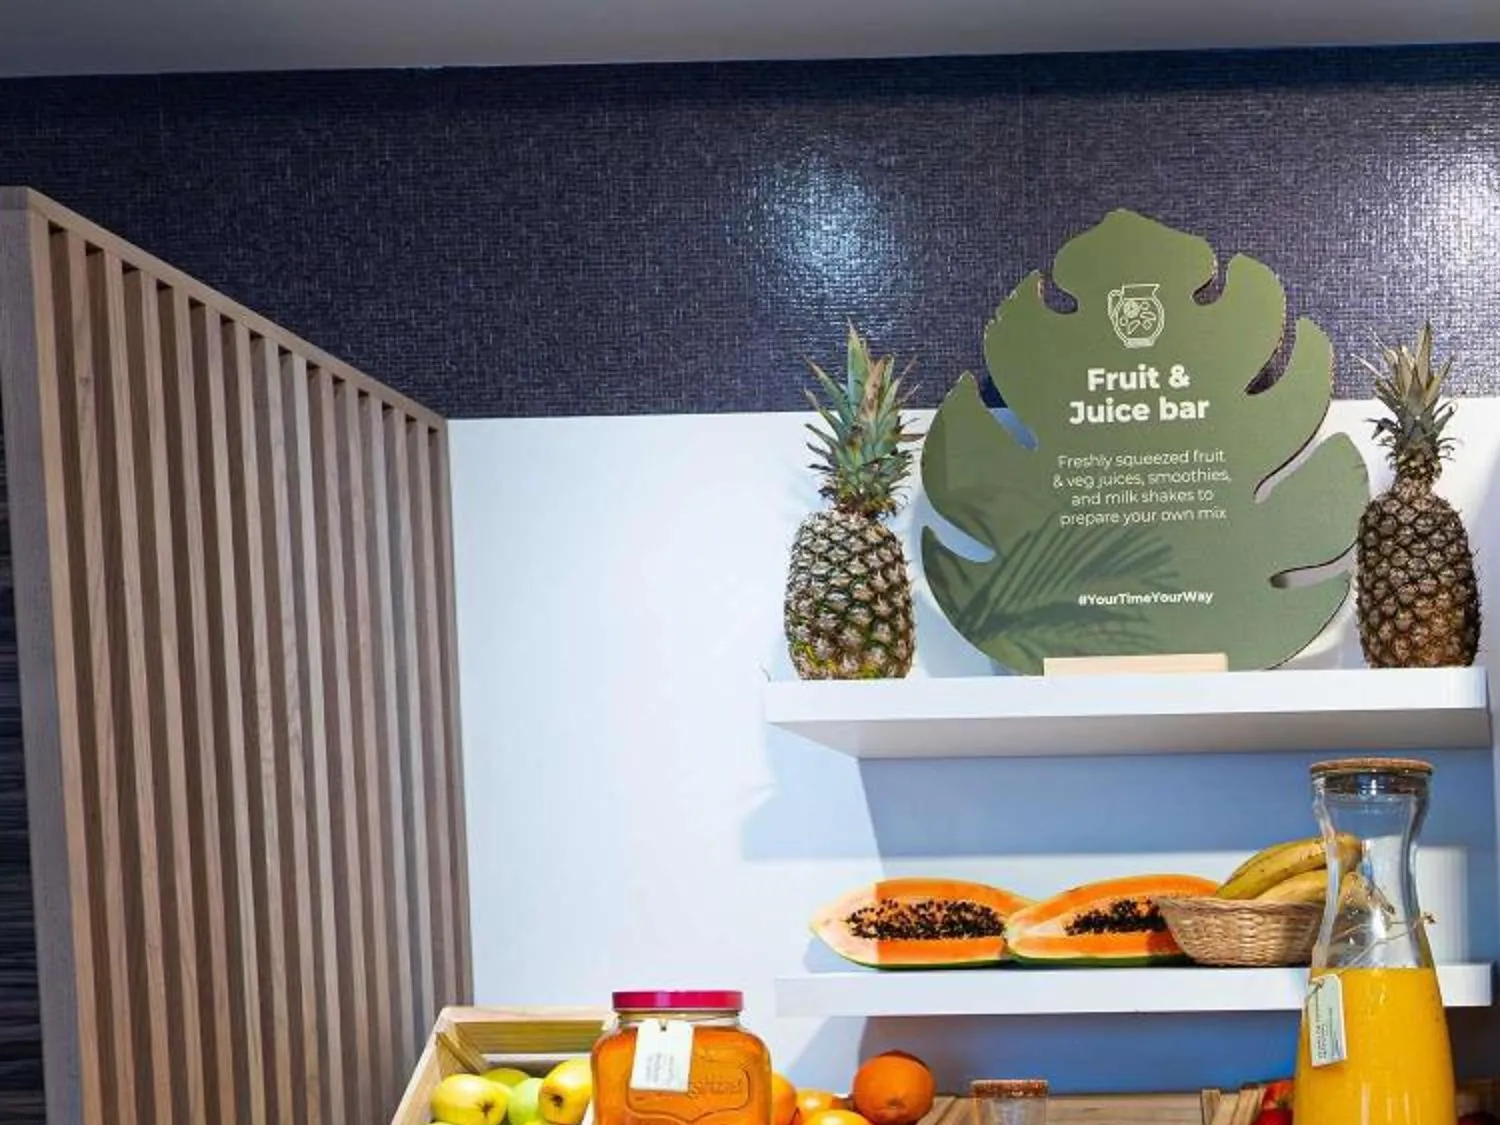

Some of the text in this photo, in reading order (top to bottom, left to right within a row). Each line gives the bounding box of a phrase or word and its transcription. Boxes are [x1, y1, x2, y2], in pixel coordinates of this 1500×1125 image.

[1087, 363, 1191, 392] Fruit &
[1069, 396, 1210, 425] Juice bar
[1057, 448, 1226, 470] Freshly squeezed fruit
[1052, 467, 1232, 489] & veg juices, smoothies,
[1071, 488, 1214, 507] and milk shakes to
[1060, 506, 1227, 528] prepare your own mix
[1078, 591, 1214, 607] #YourTimeYourWay
